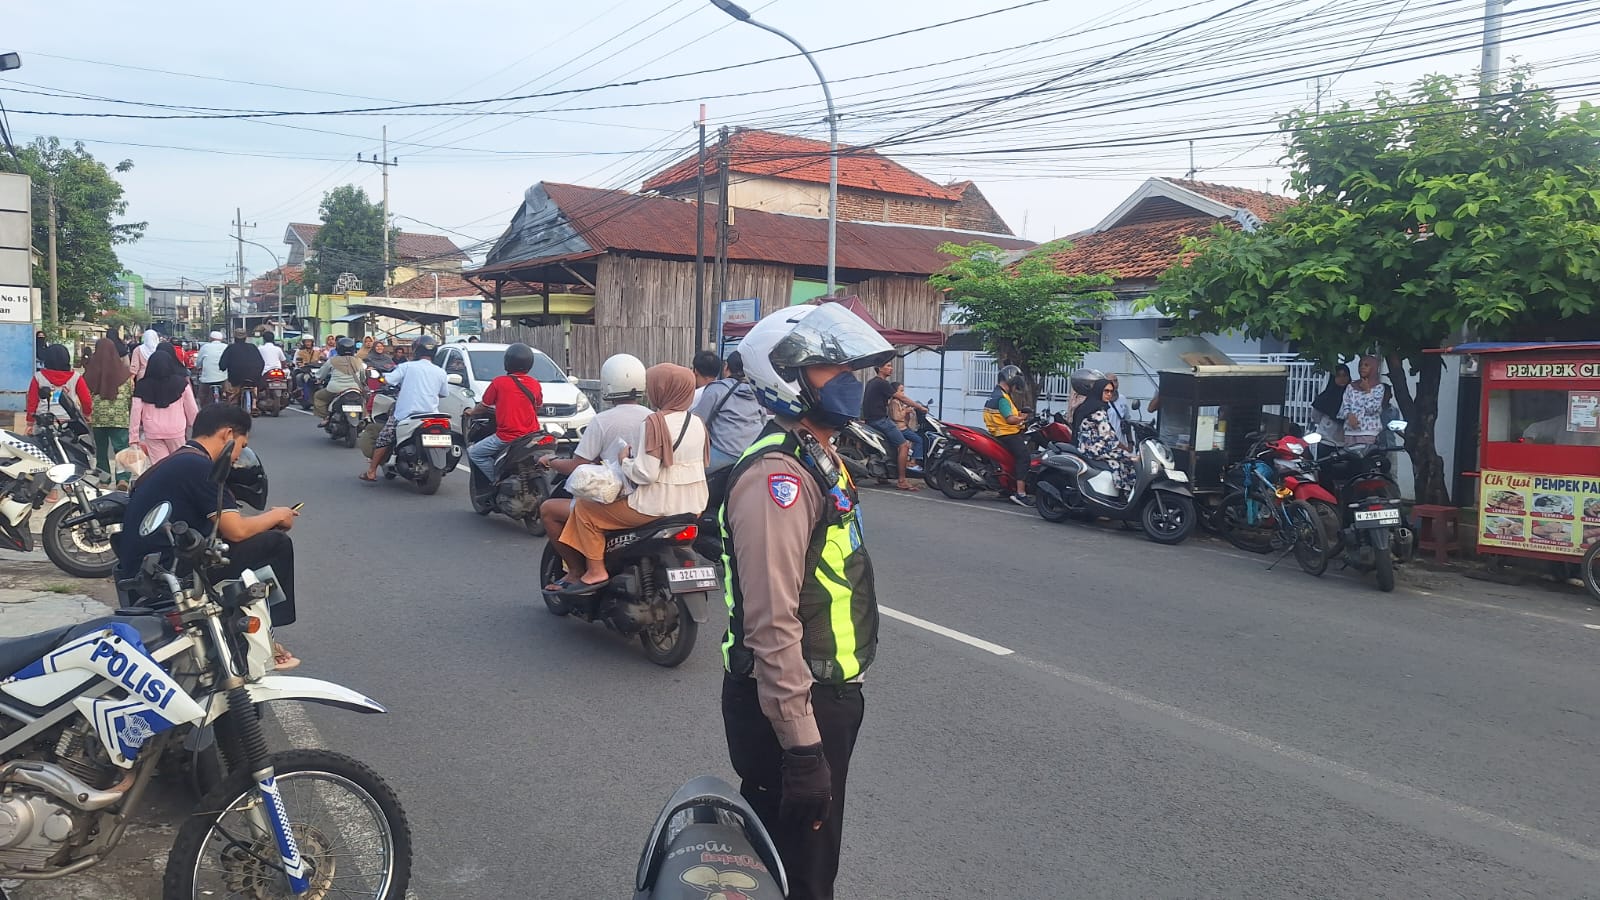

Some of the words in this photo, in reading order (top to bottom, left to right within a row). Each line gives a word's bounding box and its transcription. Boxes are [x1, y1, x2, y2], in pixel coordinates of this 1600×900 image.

[1506, 364, 1577, 377] PEMPEK
[1484, 473, 1503, 486] Cik
[1506, 475, 1532, 490] Lusi
[1534, 477, 1580, 492] PEMPEK
[90, 640, 176, 710] POLISI
[668, 841, 732, 859] Mouse
